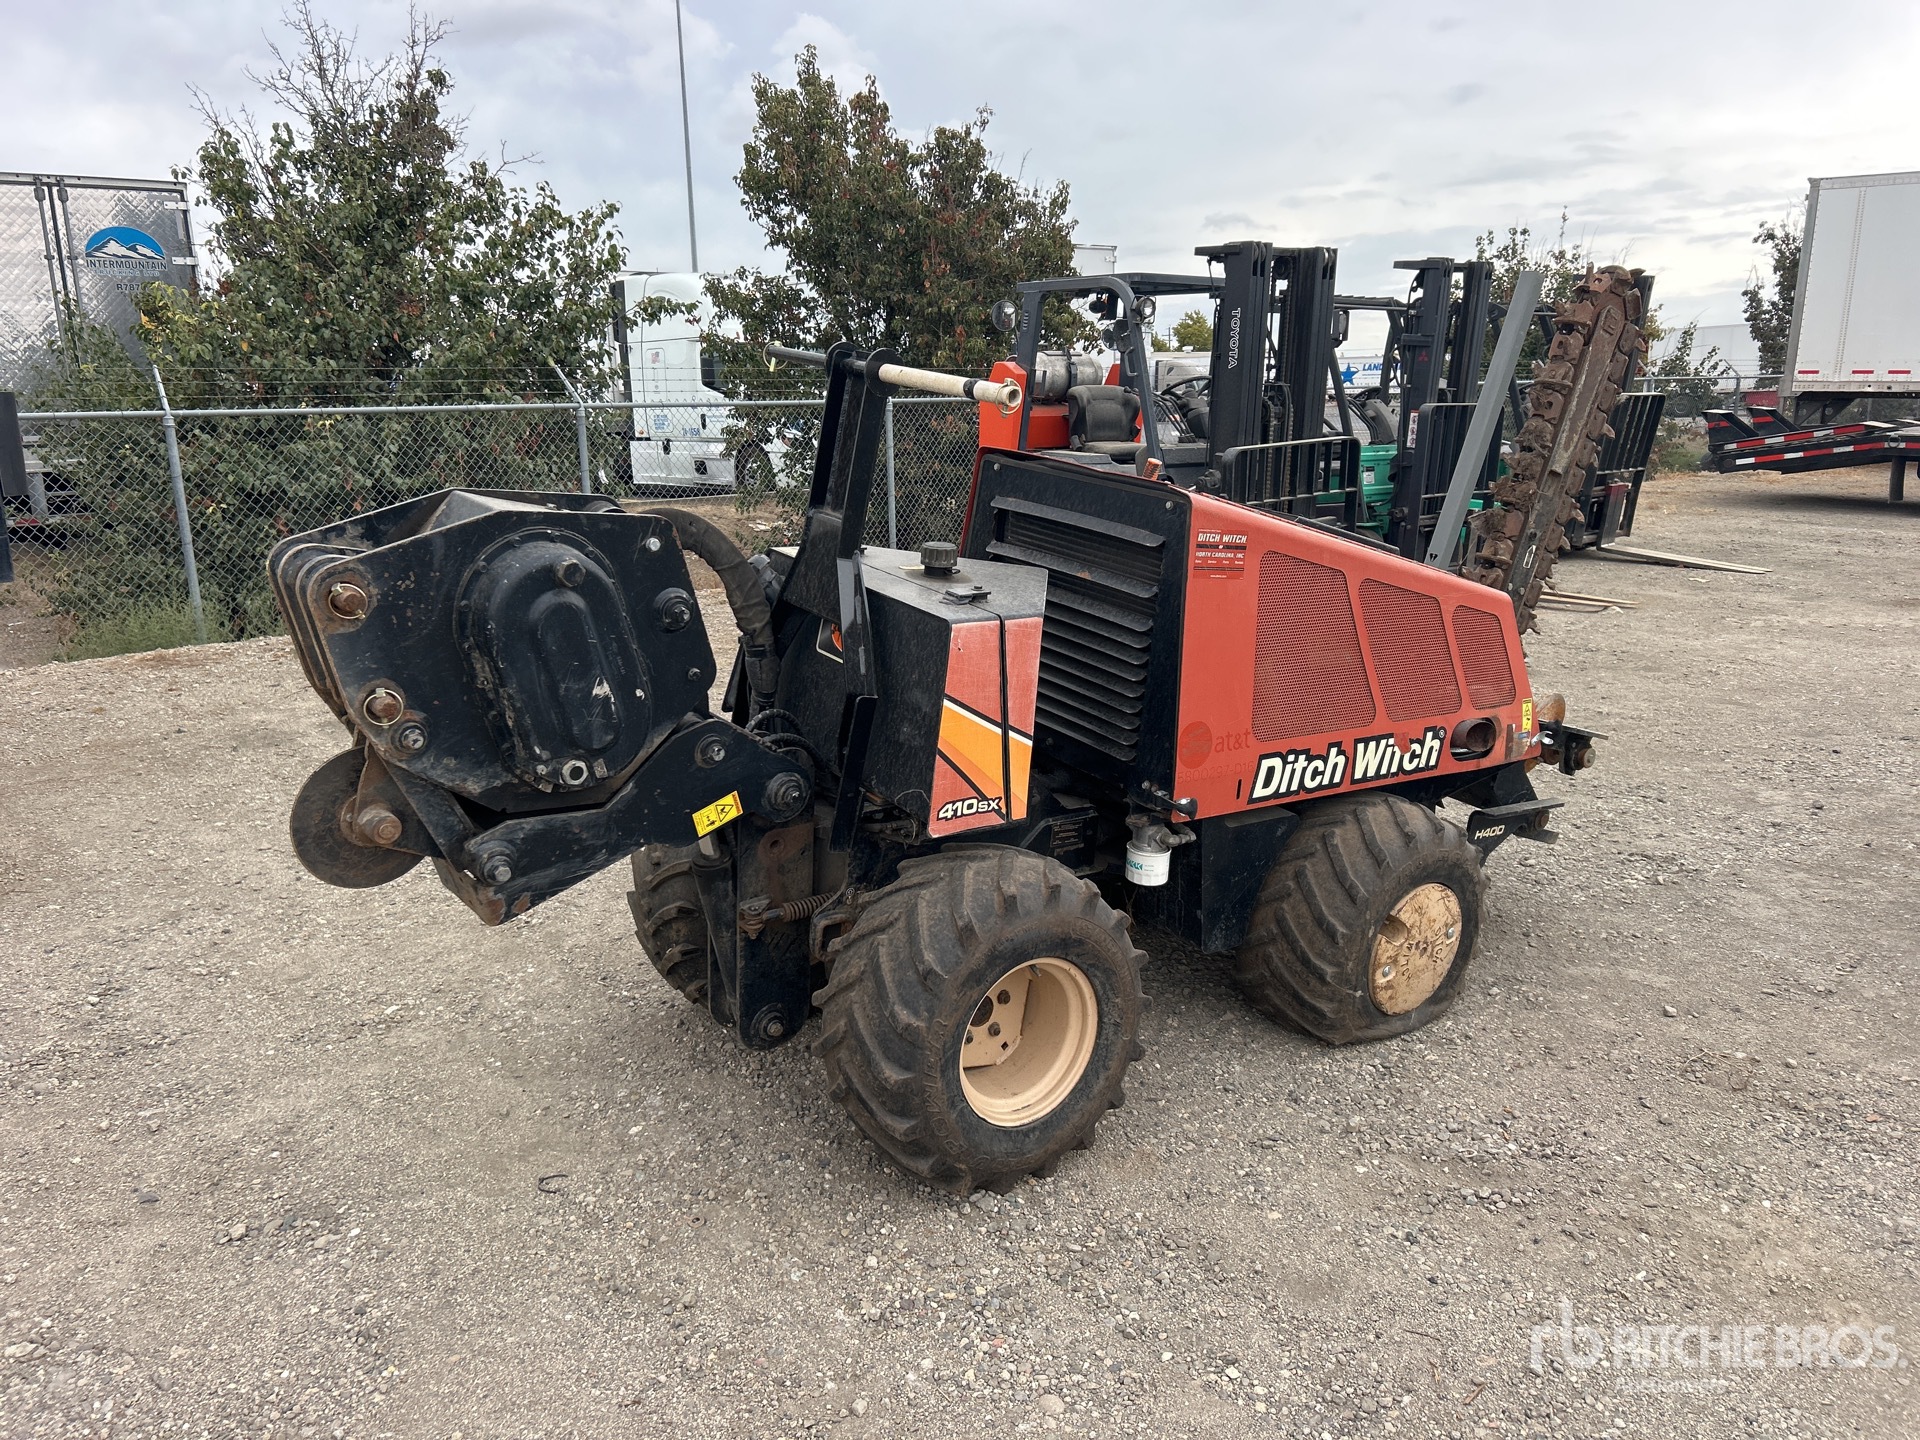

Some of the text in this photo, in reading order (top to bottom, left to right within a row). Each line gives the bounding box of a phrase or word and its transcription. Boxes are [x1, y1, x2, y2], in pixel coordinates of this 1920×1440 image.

[86, 259, 167, 270] INTERMOUNTAIN
[1228, 307, 1241, 369] TOYOTA
[1197, 533, 1248, 544] DITCH WITCH
[1214, 728, 1251, 753] at&t
[1252, 744, 1346, 800] Ditch
[1474, 824, 1505, 840] H400
